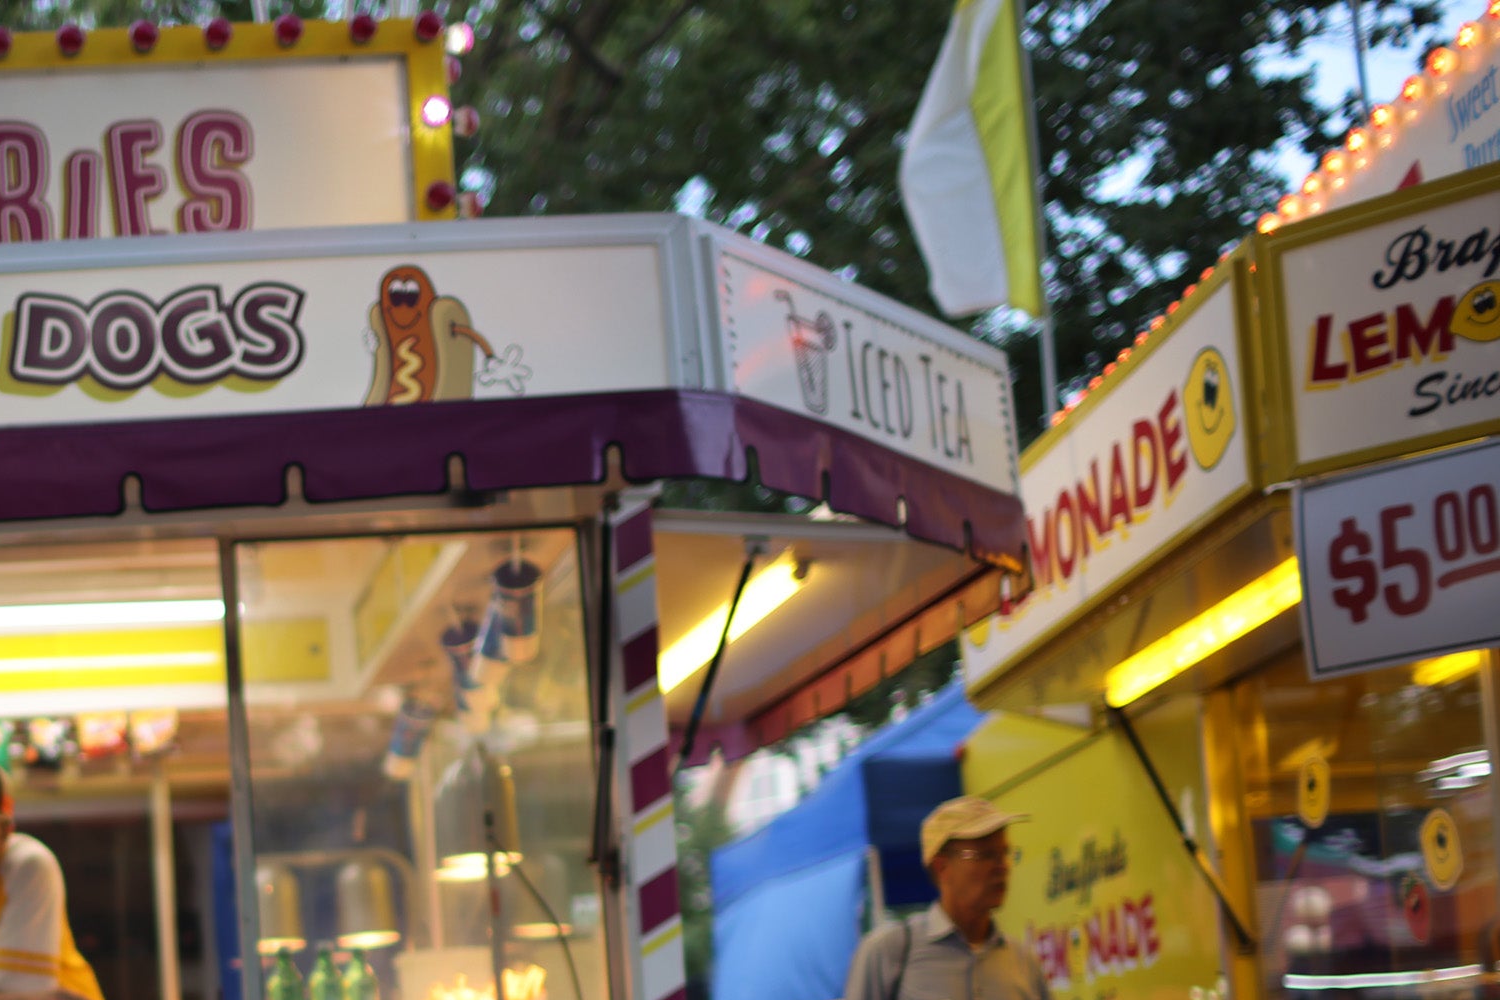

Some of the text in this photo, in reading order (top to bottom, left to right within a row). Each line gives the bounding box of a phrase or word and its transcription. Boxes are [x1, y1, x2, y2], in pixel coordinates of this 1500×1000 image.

[3, 282, 306, 393] DOGS
[843, 321, 975, 464] ICED TEA
[1000, 386, 1189, 616] MONADE
